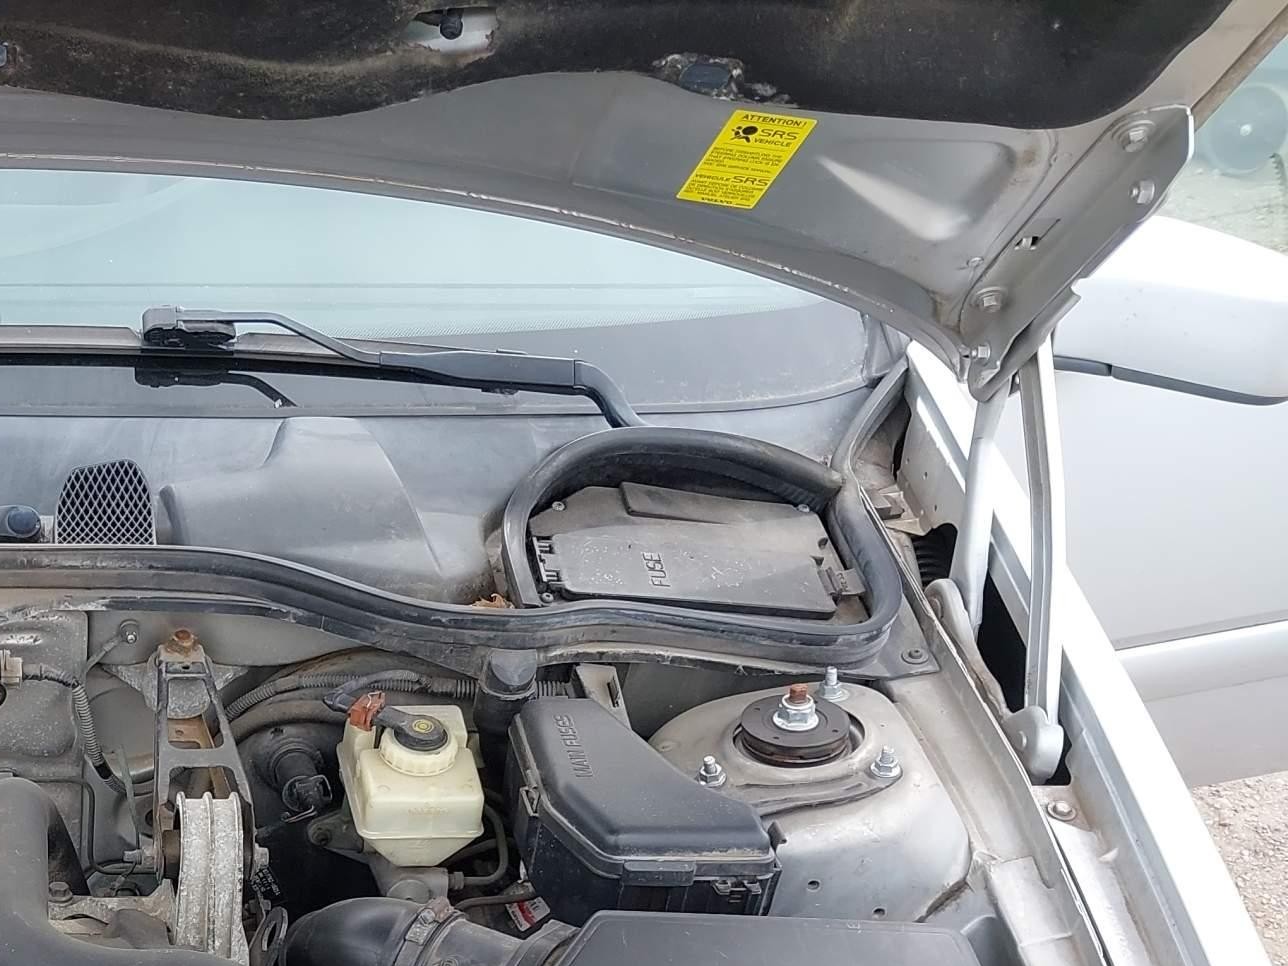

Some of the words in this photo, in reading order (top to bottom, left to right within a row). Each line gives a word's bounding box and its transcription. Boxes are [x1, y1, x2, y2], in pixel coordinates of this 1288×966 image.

[759, 128, 799, 141] SRS
[752, 137, 793, 148] VEHICLE
[731, 175, 770, 187] SRS
[640, 550, 672, 589] FUSE
